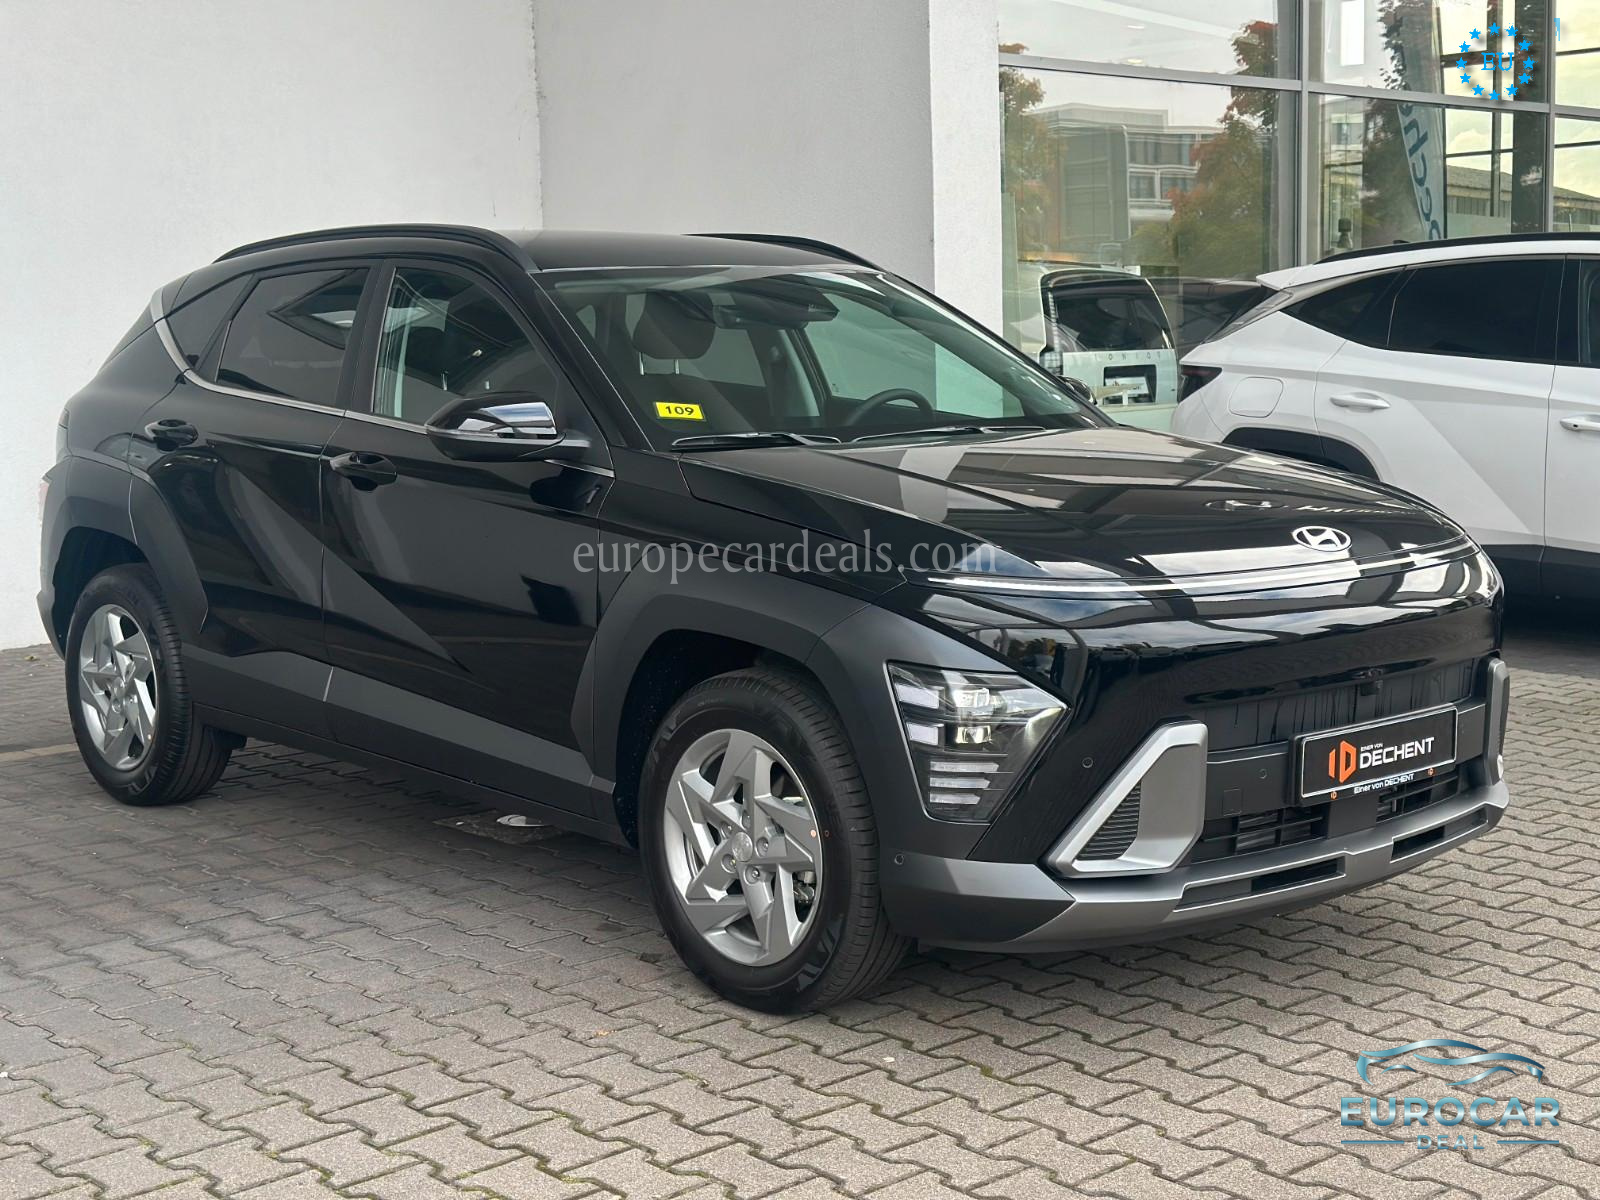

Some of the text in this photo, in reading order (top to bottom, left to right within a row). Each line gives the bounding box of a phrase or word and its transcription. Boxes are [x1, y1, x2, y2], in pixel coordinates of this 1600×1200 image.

[665, 405, 694, 415] 109
[1360, 737, 1434, 769] DECHENT
[1354, 773, 1414, 794] Einer von DECHENT
